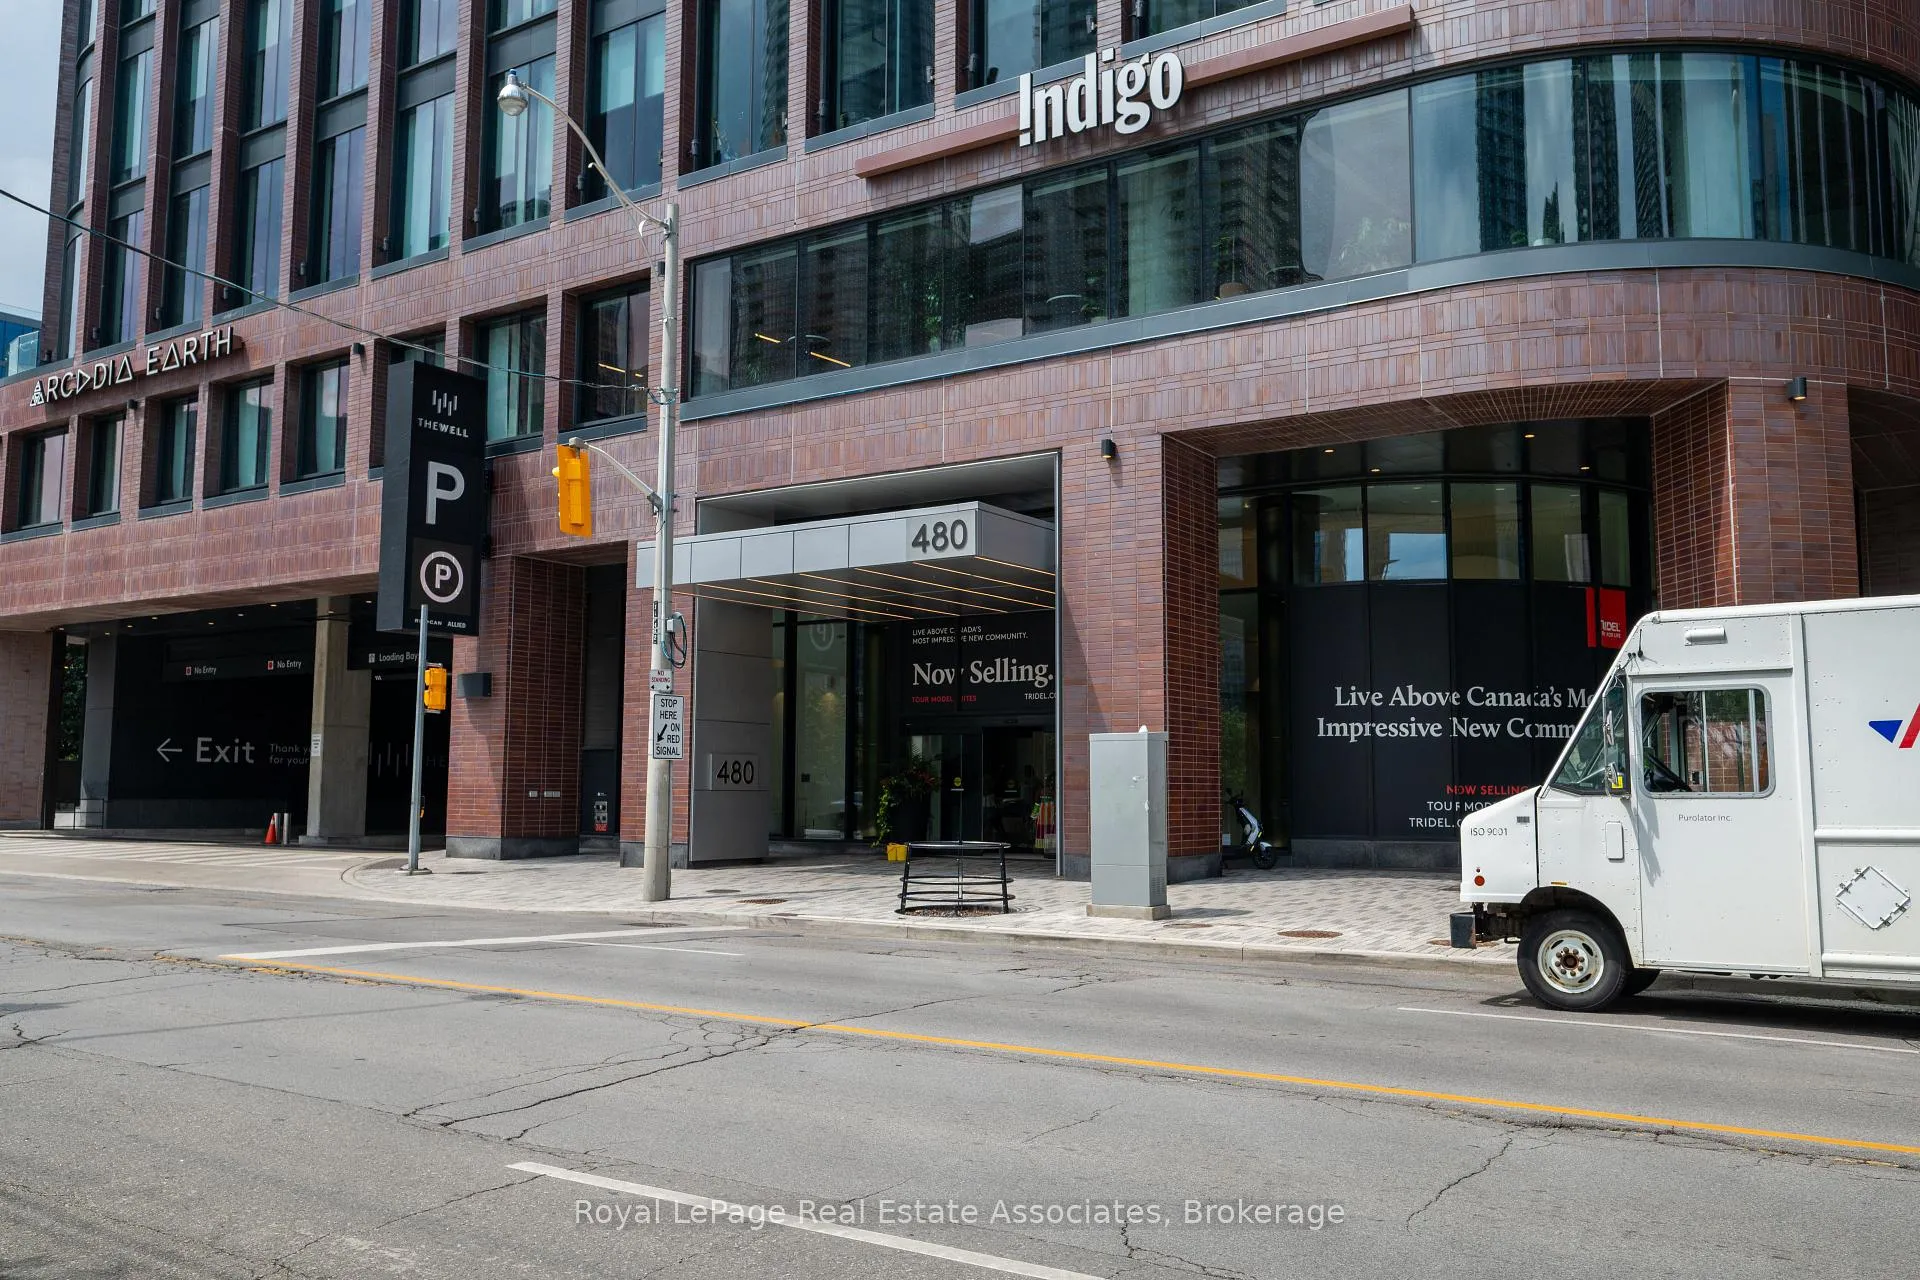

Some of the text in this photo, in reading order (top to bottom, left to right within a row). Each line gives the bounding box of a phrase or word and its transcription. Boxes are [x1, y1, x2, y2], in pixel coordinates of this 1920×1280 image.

[146, 326, 233, 376] EARTH
[425, 461, 465, 525] P
[911, 519, 968, 553] 480
[912, 637, 930, 645] MOST
[968, 634, 984, 642] NEW
[985, 632, 1029, 641] COMMUNITY.
[379, 653, 404, 663] Loading
[277, 660, 302, 670] No Entry
[970, 657, 1054, 688] Selling.
[1334, 685, 1383, 706] Live
[1388, 684, 1461, 706] Above
[660, 698, 678, 708] STOP
[659, 711, 678, 720] HERE
[670, 723, 681, 732] ON
[1316, 716, 1443, 743] Impressive
[1449, 716, 1502, 738] New
[667, 734, 681, 744] RED
[196, 737, 255, 764] Exit
[269, 743, 301, 753] Thank
[656, 746, 681, 756] SIGNAL
[269, 754, 309, 767] for your
[716, 760, 754, 785] 480
[1678, 813, 1733, 822] Purolator Inc.
[1470, 827, 1485, 836] ISO
